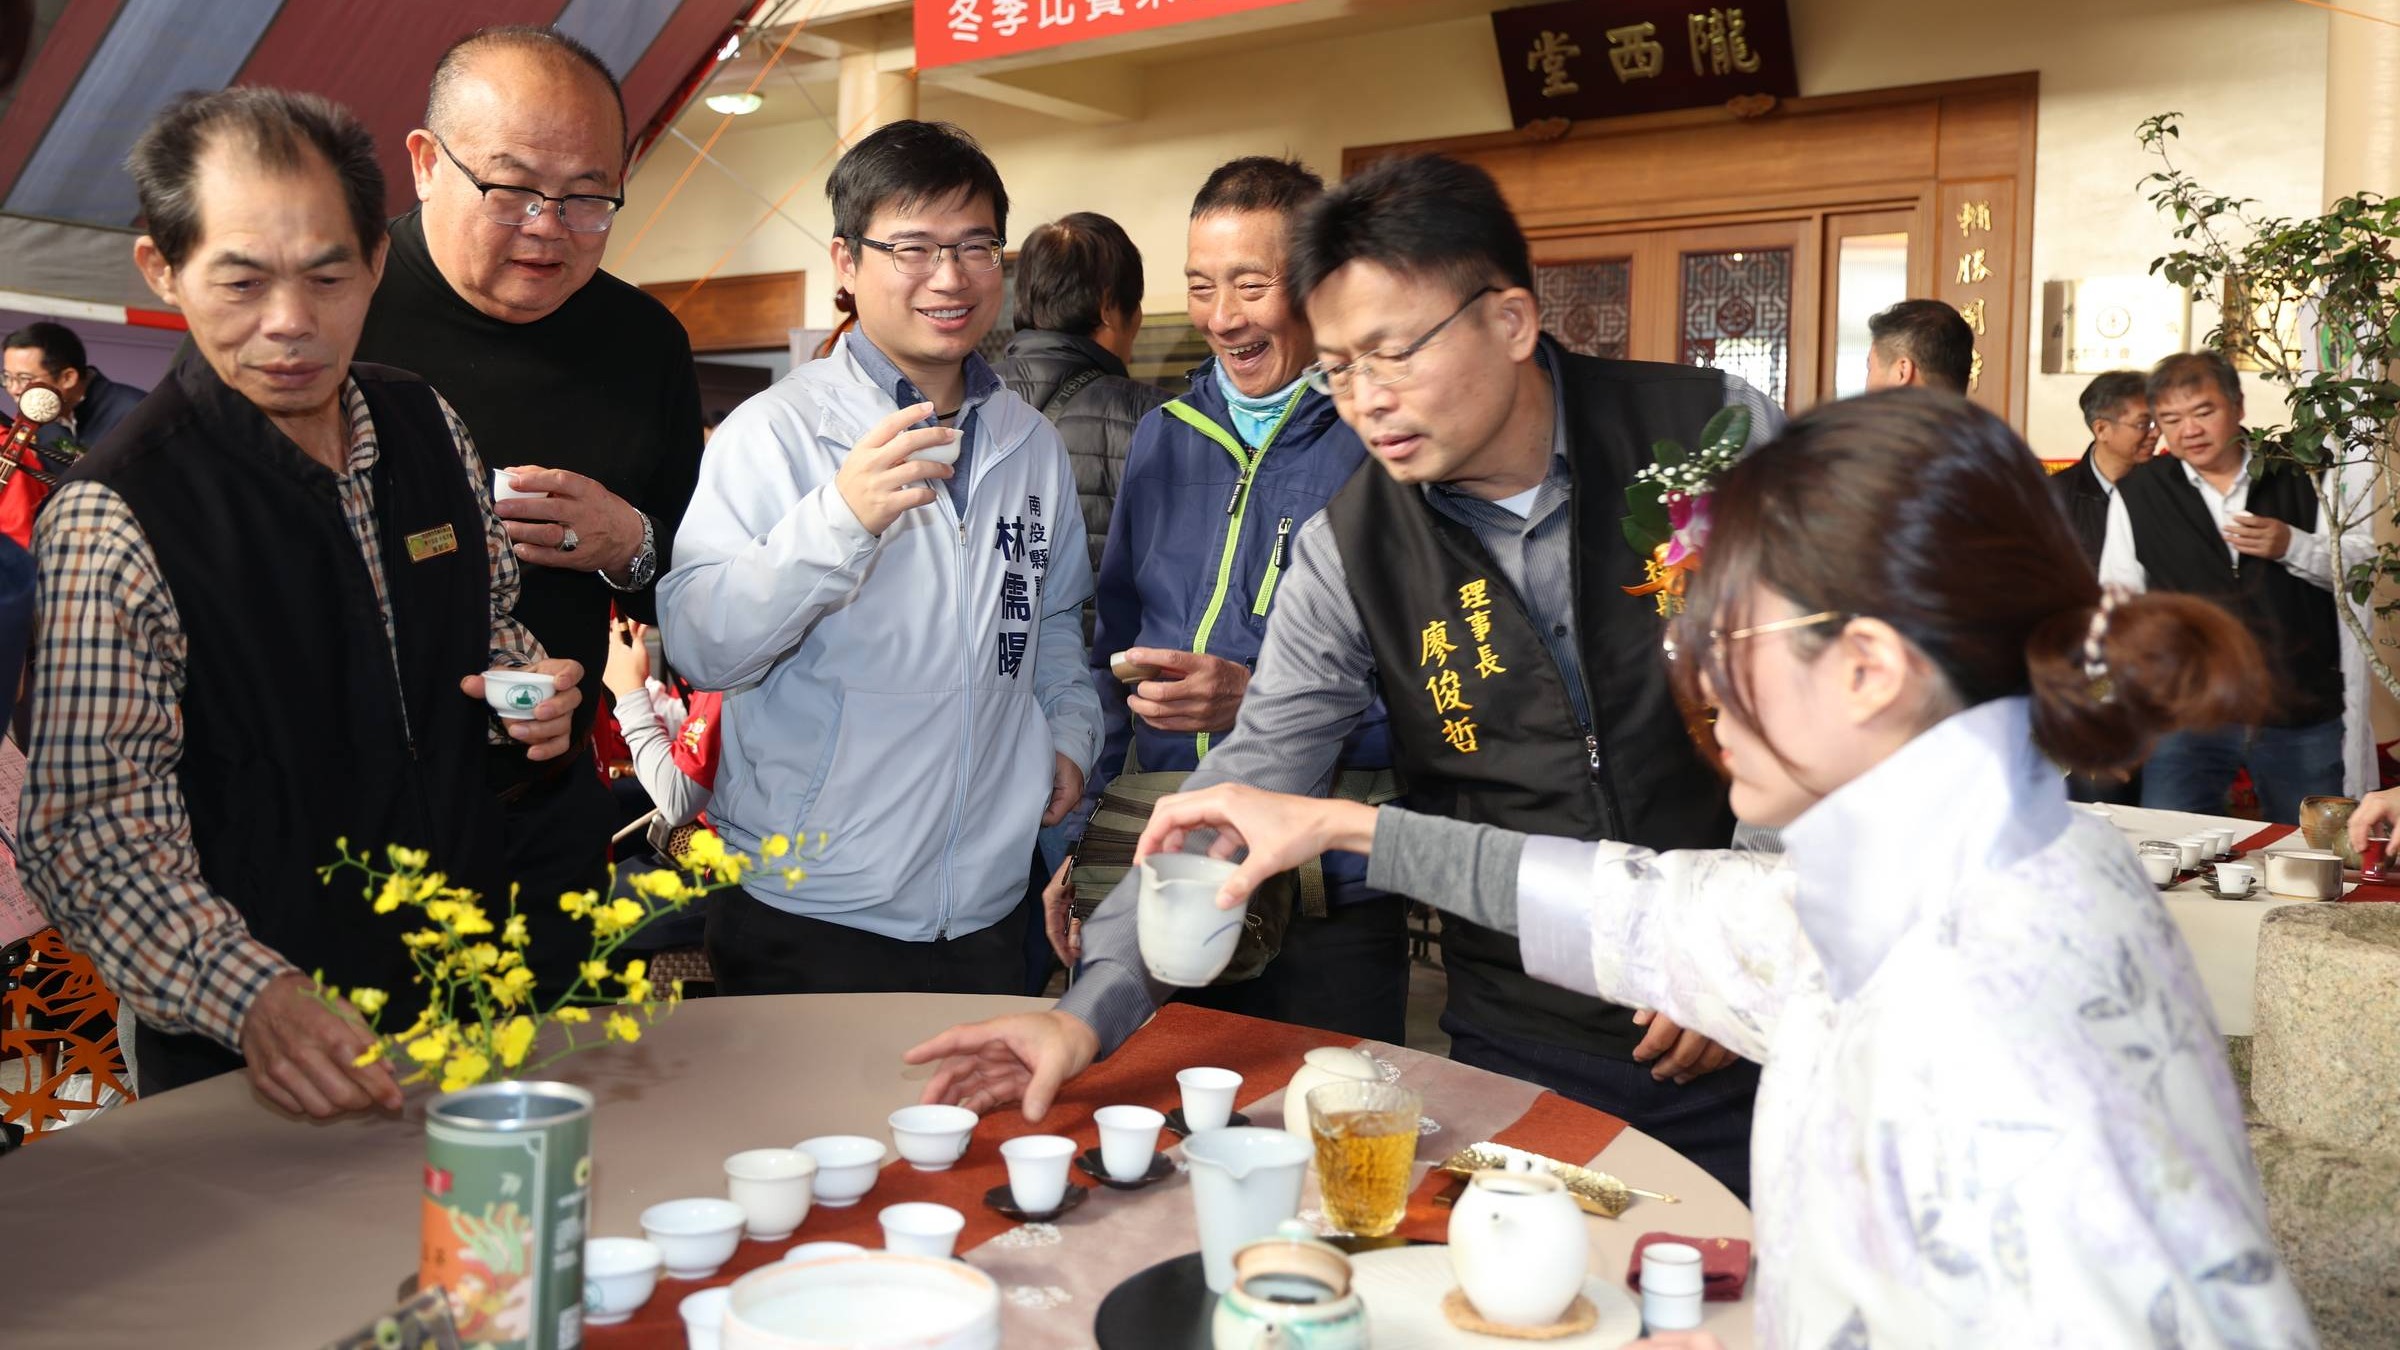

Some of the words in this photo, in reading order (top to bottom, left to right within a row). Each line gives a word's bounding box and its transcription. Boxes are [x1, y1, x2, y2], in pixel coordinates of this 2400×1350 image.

[1420, 620, 1479, 753] 廖俊哲
[1458, 578, 1507, 679] 理事長
